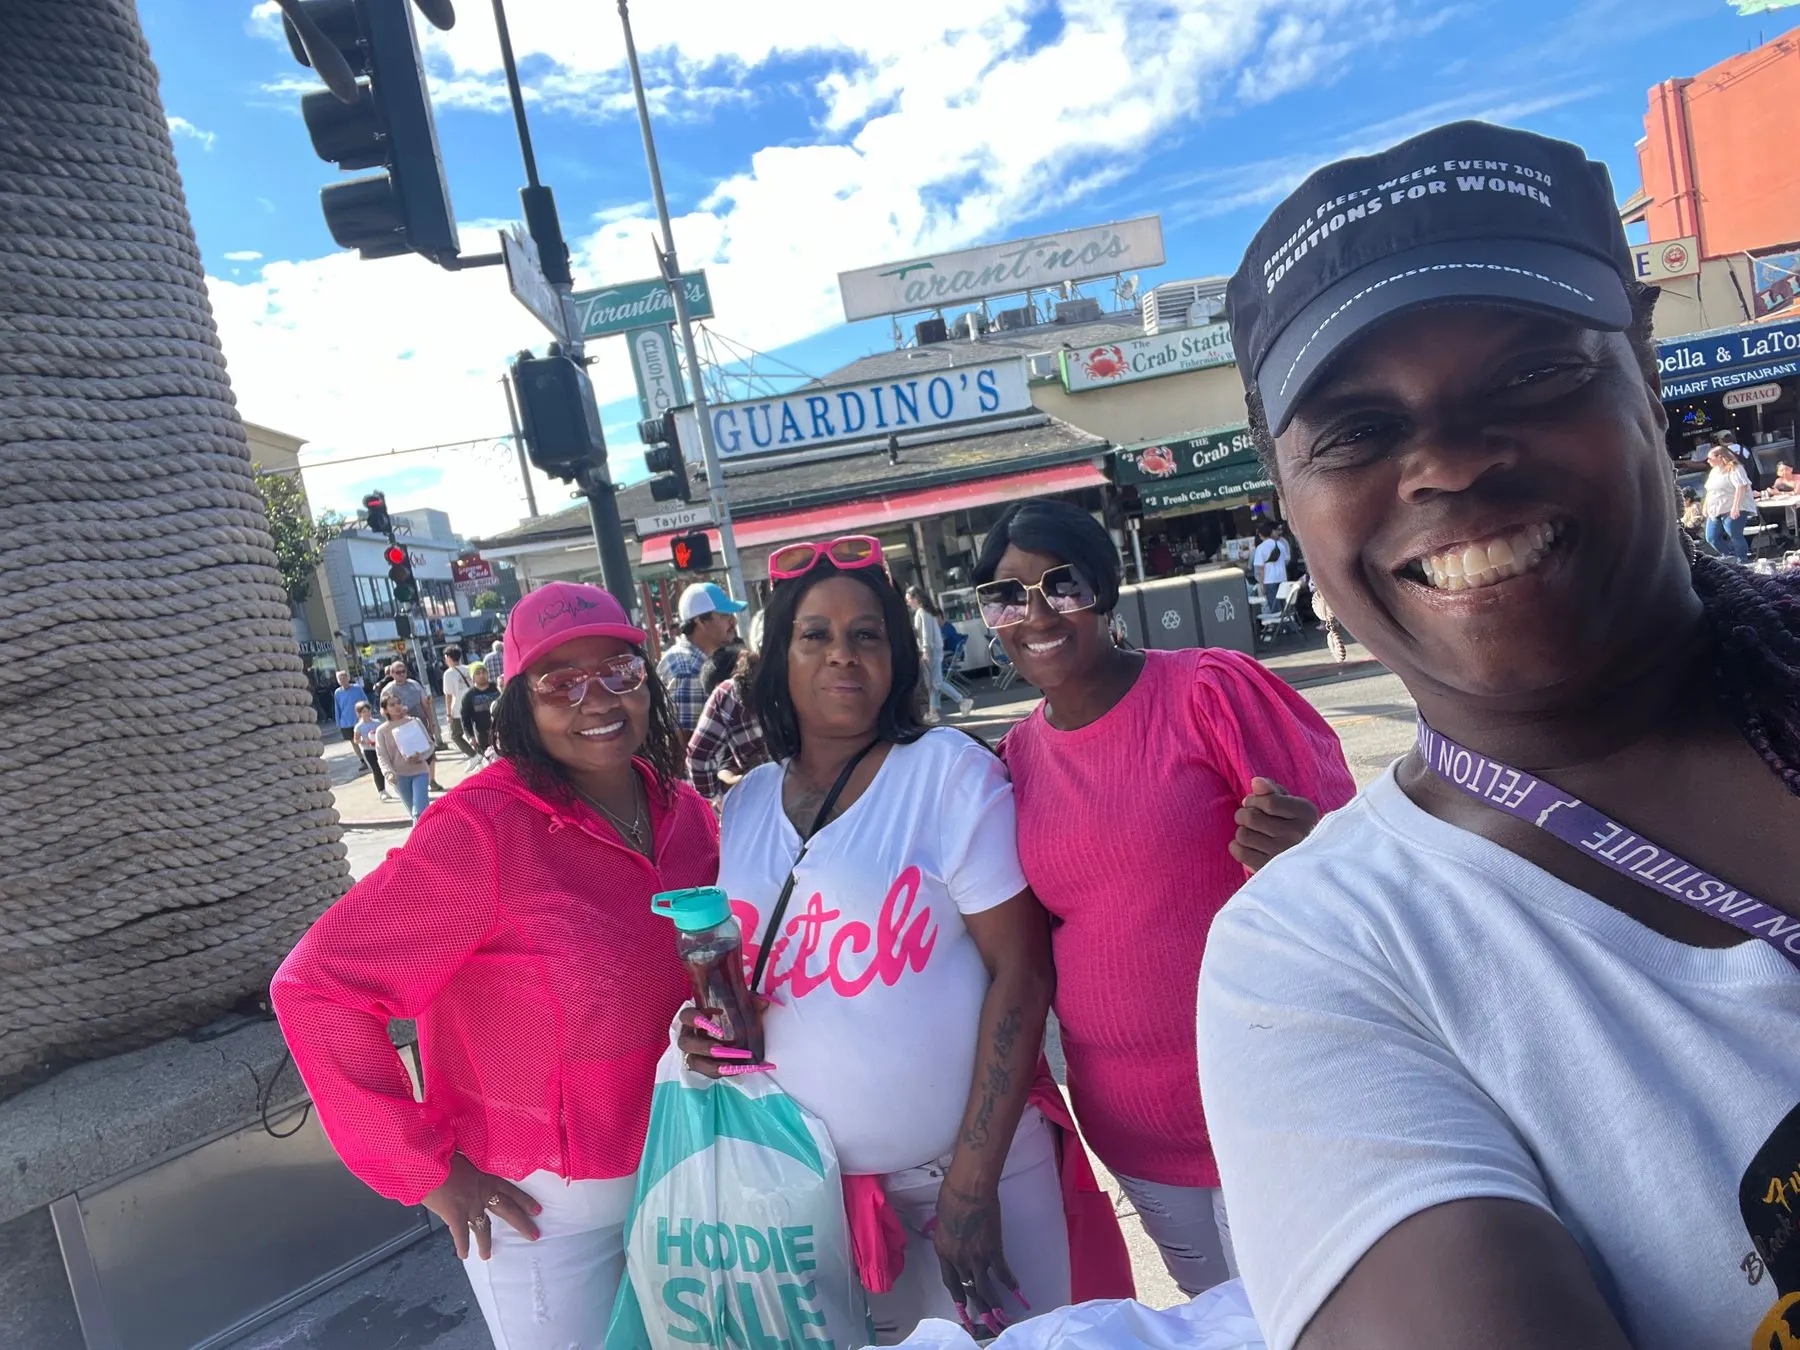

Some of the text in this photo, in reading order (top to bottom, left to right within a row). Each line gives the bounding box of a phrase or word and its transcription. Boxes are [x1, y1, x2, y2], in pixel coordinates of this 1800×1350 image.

[1264, 160, 1552, 276] ANNUAL FLEET WEEK EVENT 2024
[1266, 175, 1552, 294] SOLUTIONS FOR WOMEN
[878, 231, 1131, 302] Tarantno's
[575, 282, 705, 333] Tarantin's
[1131, 340, 1150, 350] The
[1132, 344, 1178, 373] Crab
[1716, 346, 1732, 363] &
[1741, 330, 1800, 358] LaTo
[1661, 362, 1798, 398] WHARF RESTAURANT
[1727, 387, 1778, 405] ENTRANCE
[713, 368, 1000, 454] GUARDINO'S
[1189, 437, 1208, 448] THE
[1192, 443, 1229, 468] Crab
[1162, 493, 1188, 506] Fresh
[1189, 488, 1212, 501] Crab
[1218, 484, 1243, 495] Clam
[653, 513, 696, 528] Taylor
[1438, 740, 1538, 809] FELTON
[1580, 821, 1764, 918] INSTITUTE
[656, 1215, 817, 1275] HOODIE
